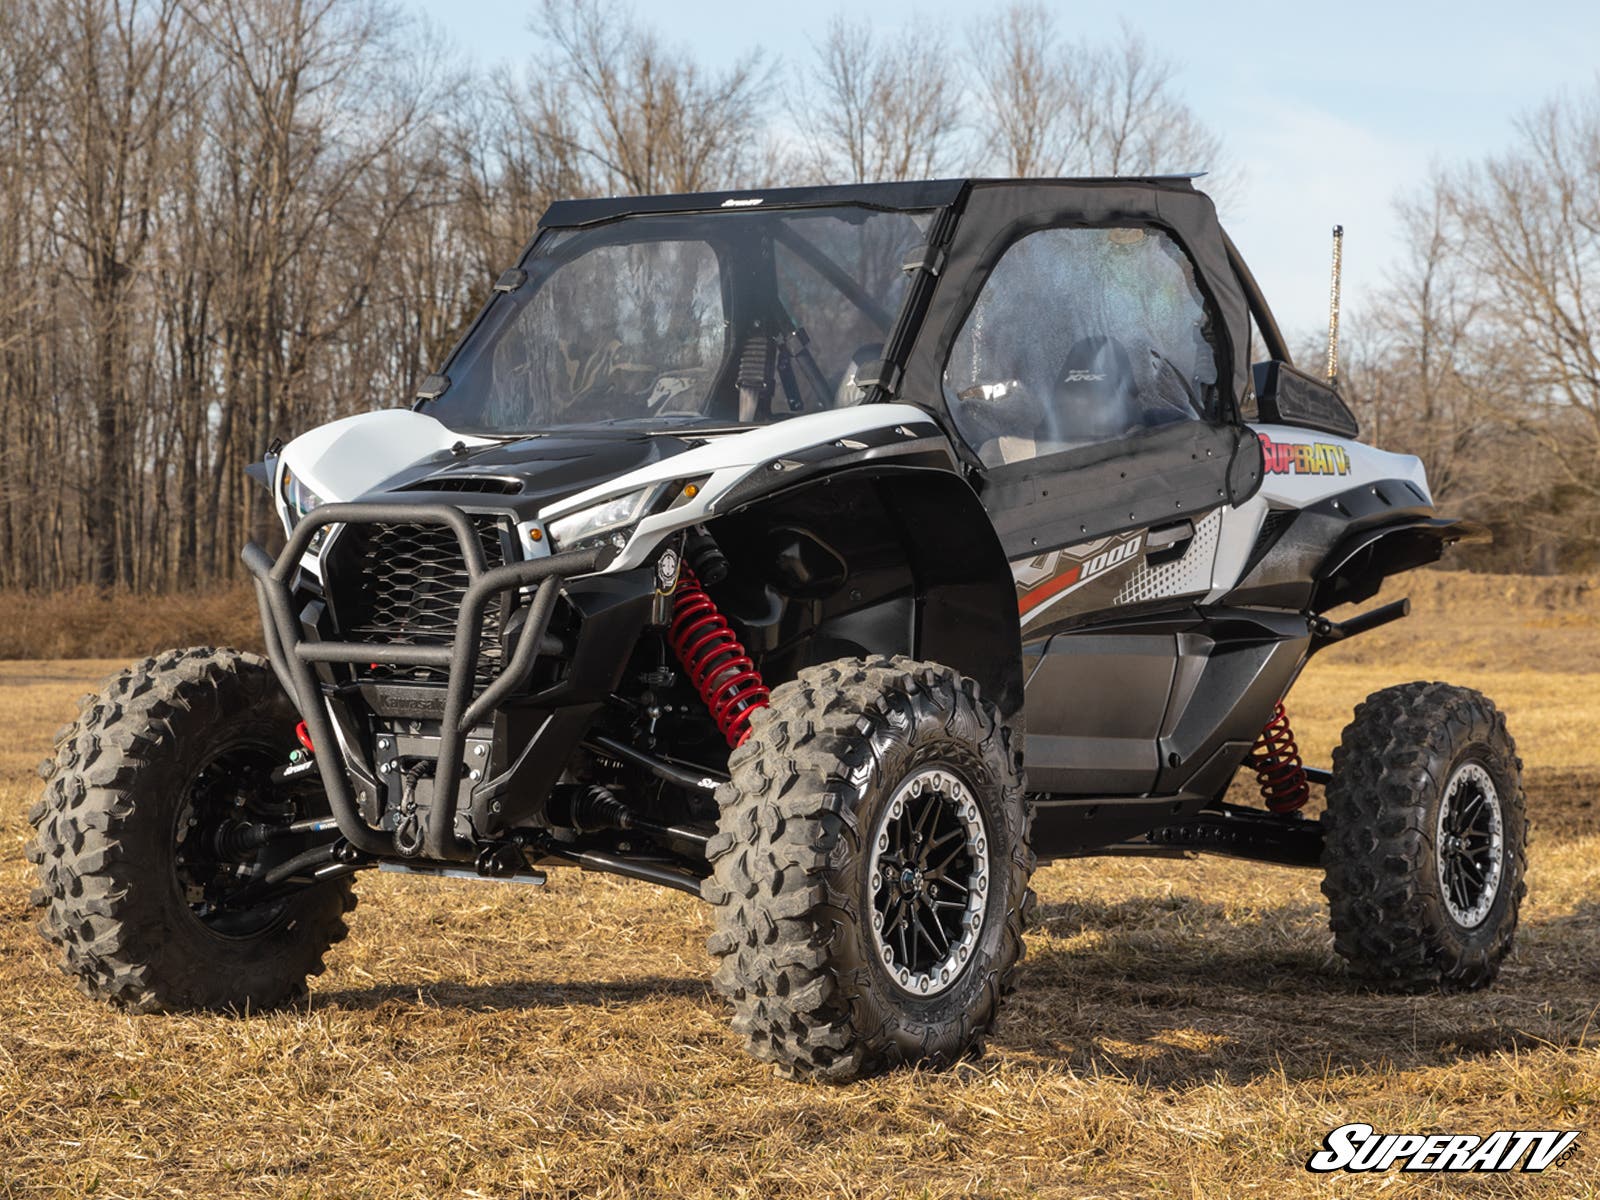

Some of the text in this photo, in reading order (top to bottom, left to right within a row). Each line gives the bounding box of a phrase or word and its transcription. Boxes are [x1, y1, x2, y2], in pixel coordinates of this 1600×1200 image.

[1257, 433, 1347, 475] SUPERATV
[1079, 535, 1142, 580] 1000
[380, 693, 448, 711] Kawasak
